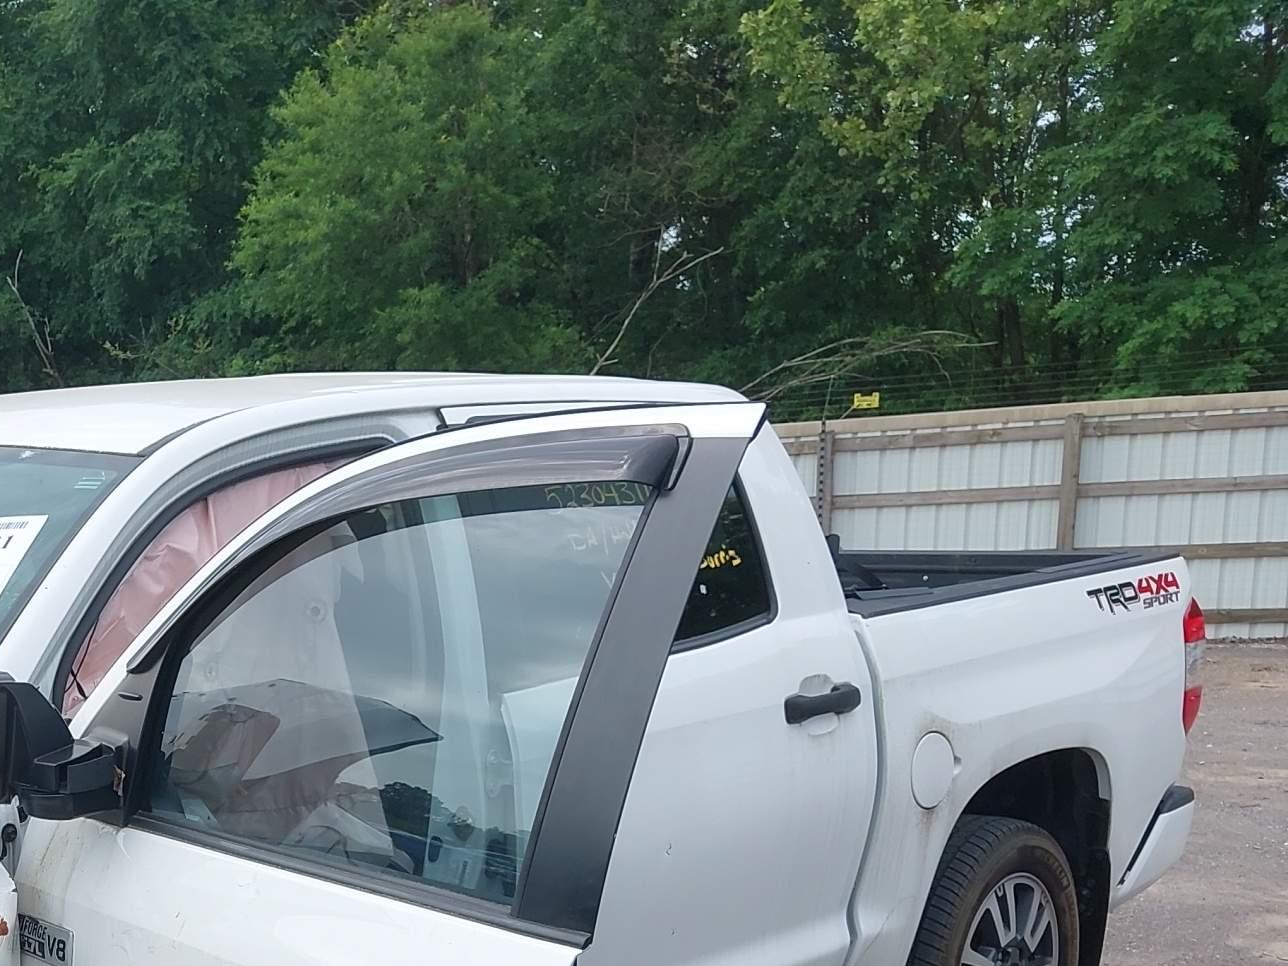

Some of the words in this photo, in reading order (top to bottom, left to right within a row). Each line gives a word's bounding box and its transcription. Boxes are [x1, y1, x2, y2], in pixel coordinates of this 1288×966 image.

[1086, 581, 1139, 615] TRD
[1142, 591, 1181, 610] SPORT
[47, 935, 67, 962] V8
